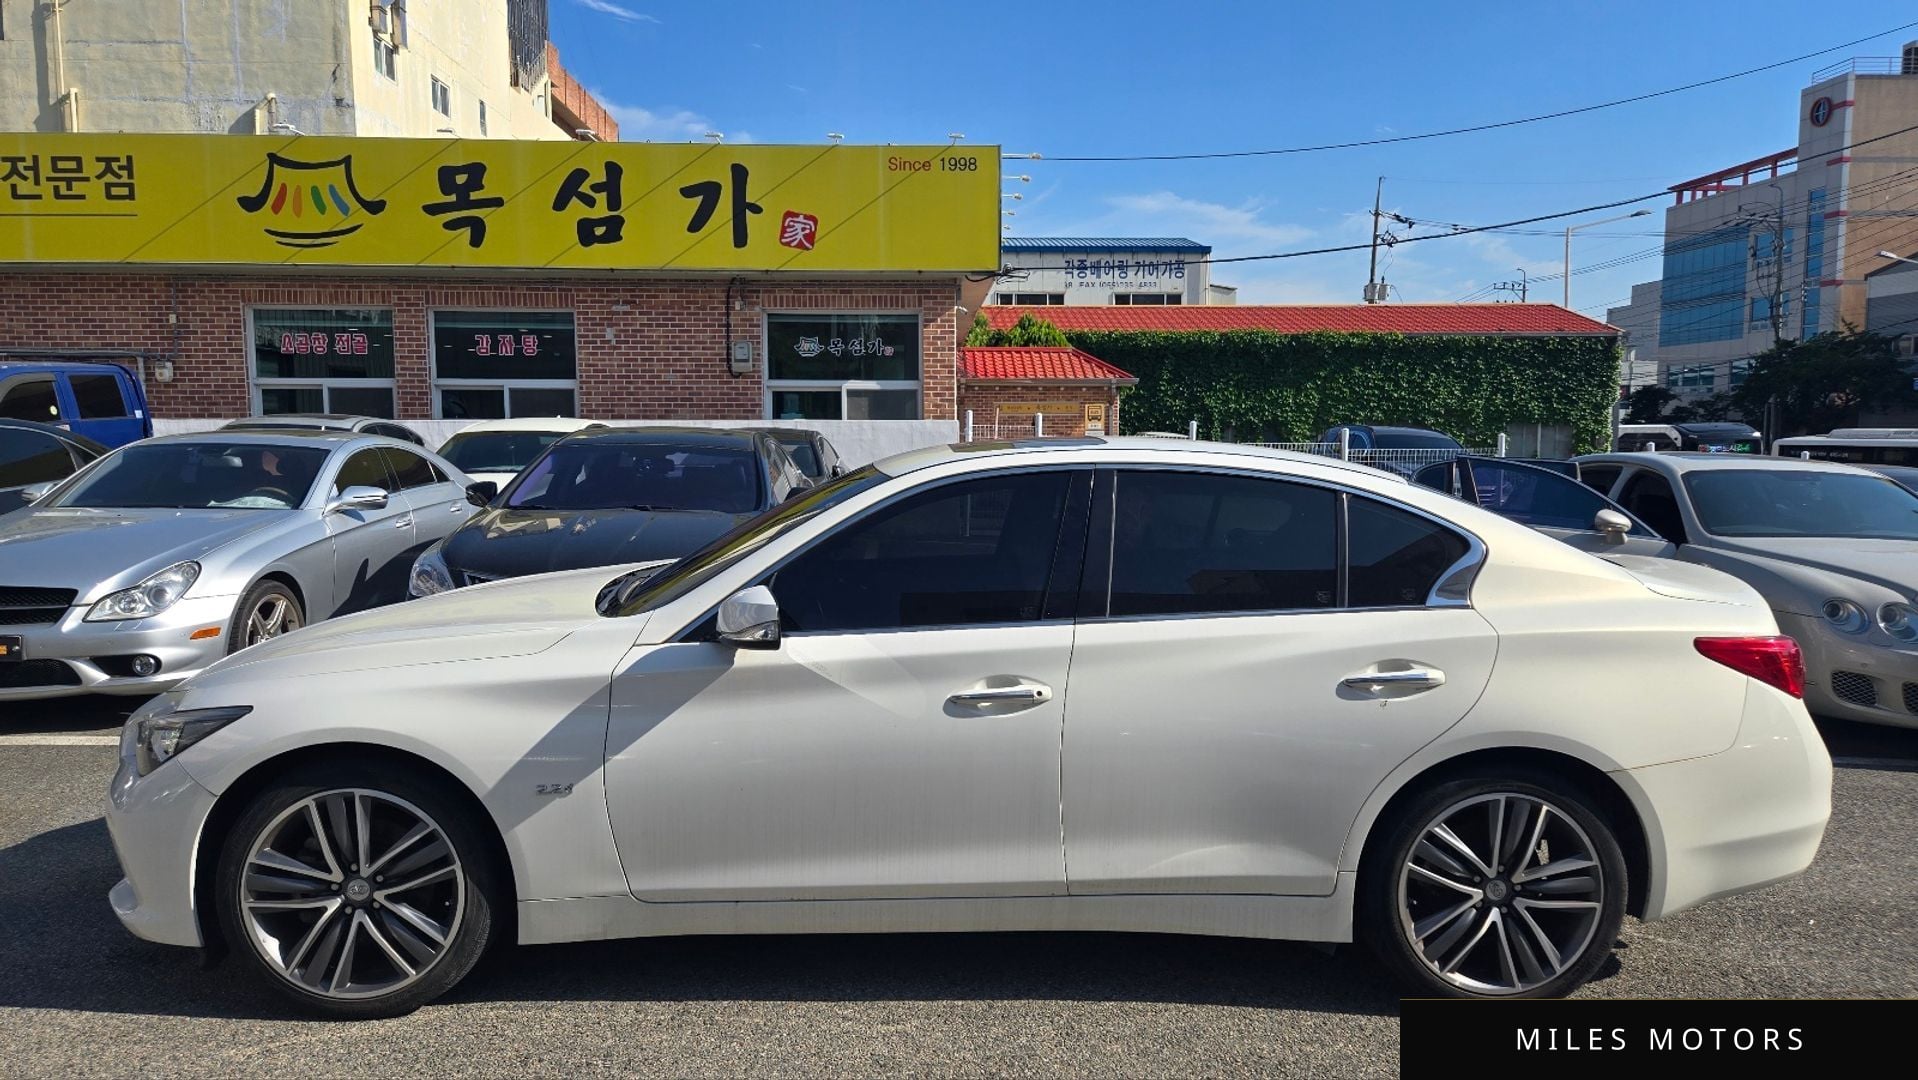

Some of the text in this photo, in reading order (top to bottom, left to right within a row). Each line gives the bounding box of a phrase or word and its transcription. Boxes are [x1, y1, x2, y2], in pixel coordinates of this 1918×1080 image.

[888, 156, 979, 175] Since 1998
[0, 154, 136, 201] 전문점
[334, 333, 368, 355] 전골
